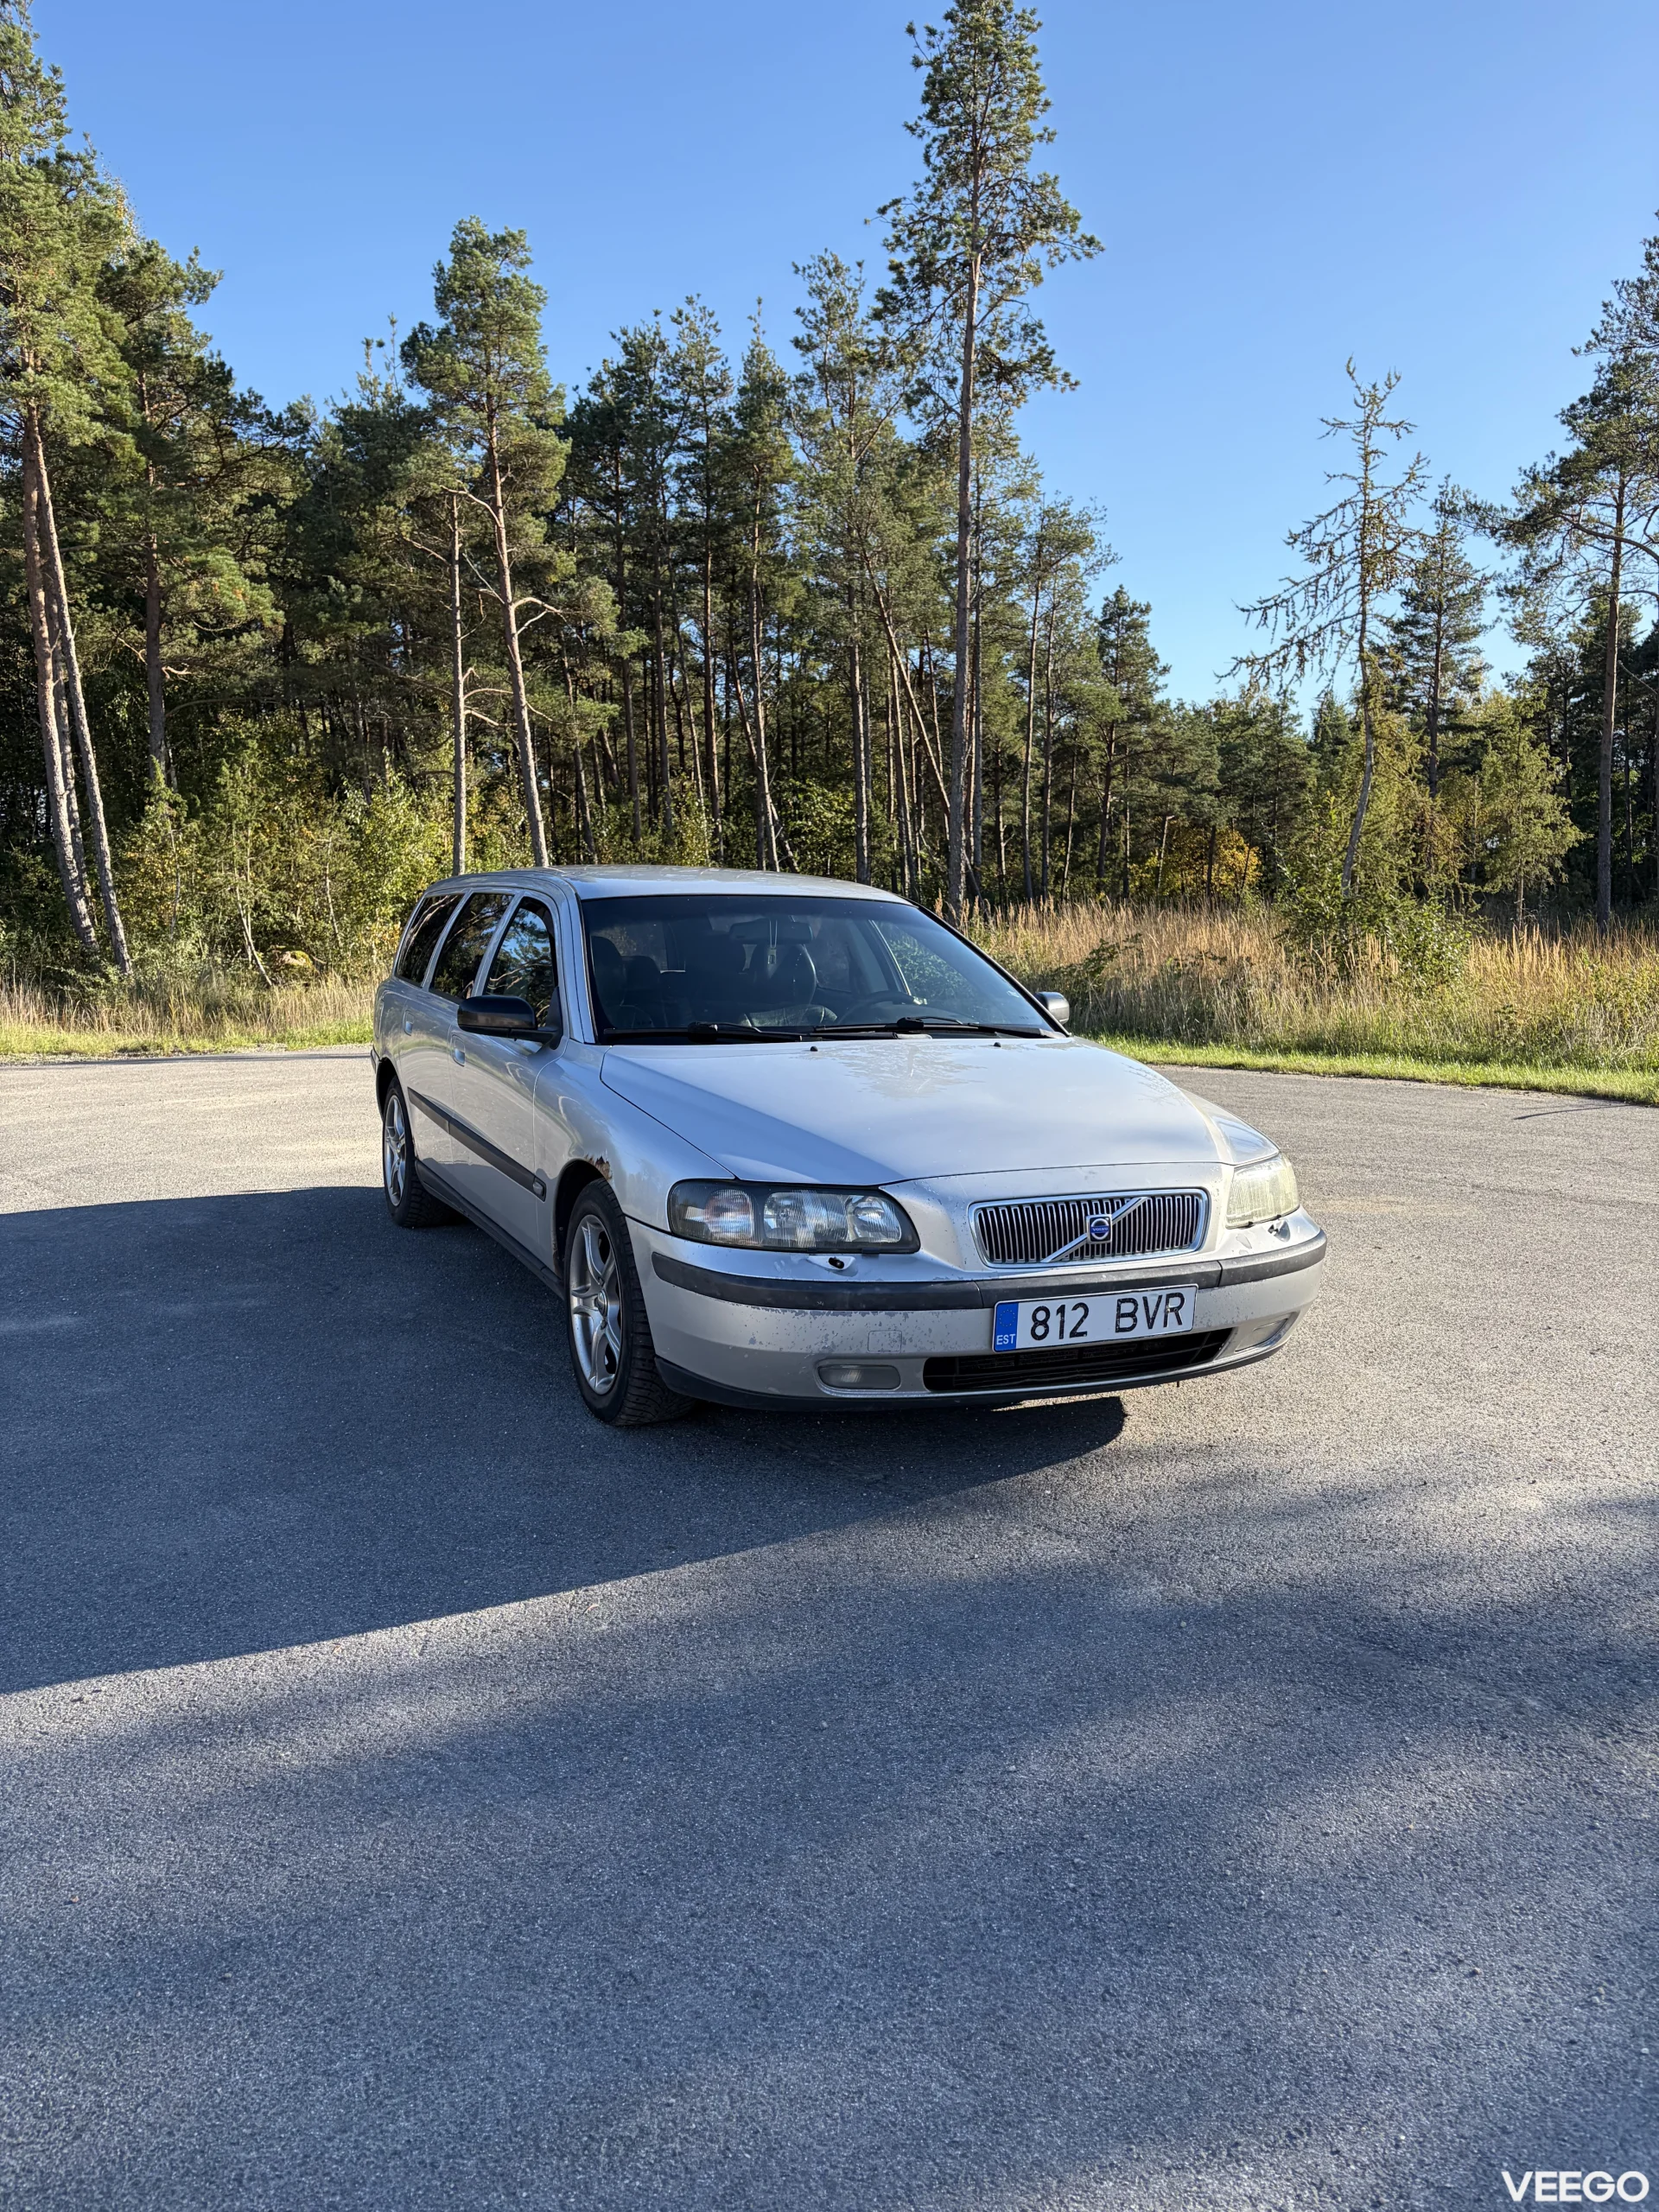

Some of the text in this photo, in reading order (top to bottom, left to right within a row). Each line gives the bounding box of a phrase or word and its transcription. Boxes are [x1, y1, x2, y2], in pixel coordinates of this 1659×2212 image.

[1030, 1292, 1185, 1341] 812 BVR
[996, 1333, 1016, 1345] EST
